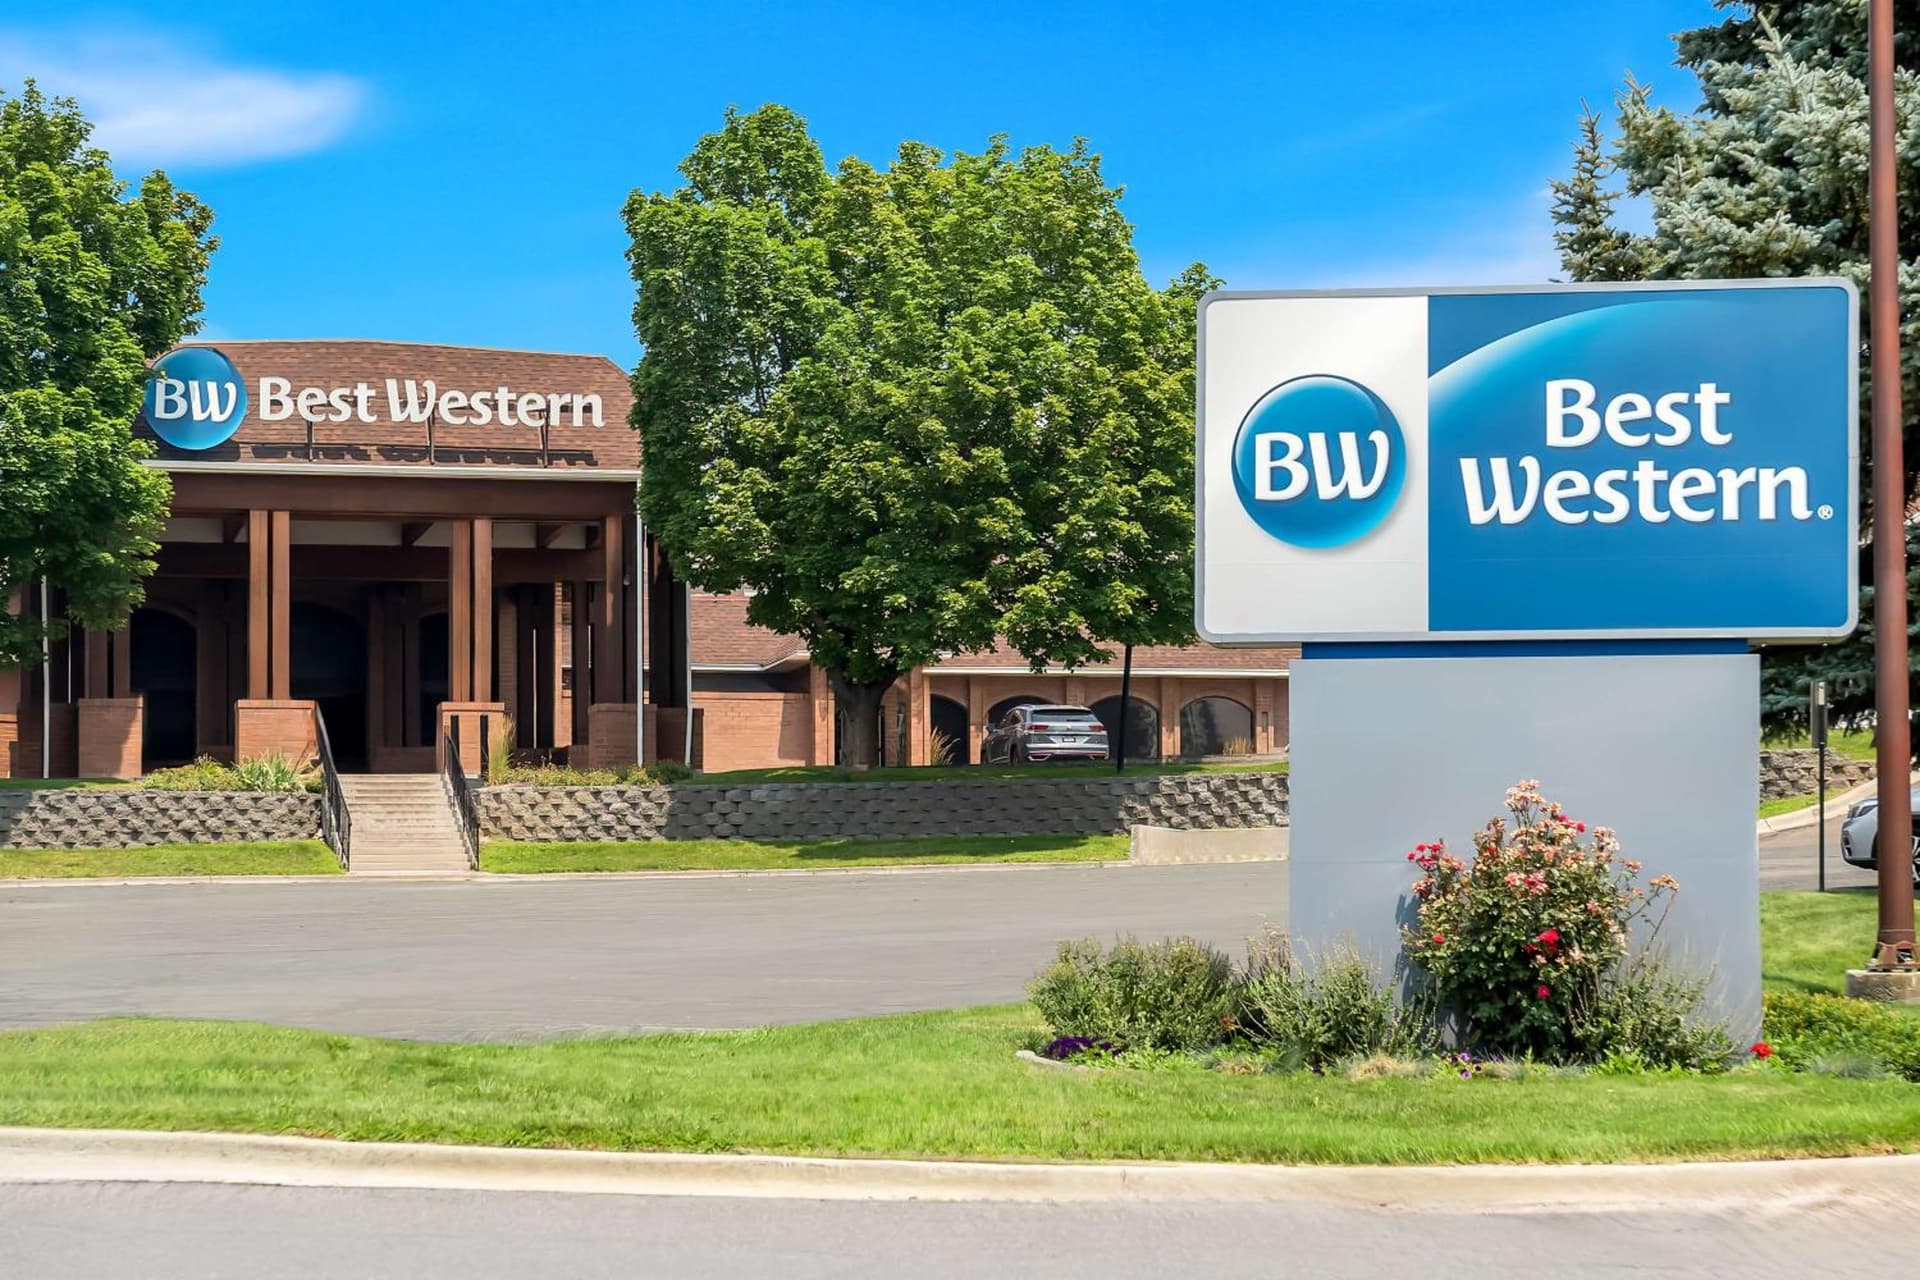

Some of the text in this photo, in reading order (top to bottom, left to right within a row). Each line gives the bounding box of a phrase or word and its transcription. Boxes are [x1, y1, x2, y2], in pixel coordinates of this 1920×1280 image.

[154, 376, 605, 427] BW Best Western
[1545, 378, 1733, 447] Best
[1254, 430, 1390, 501] BW
